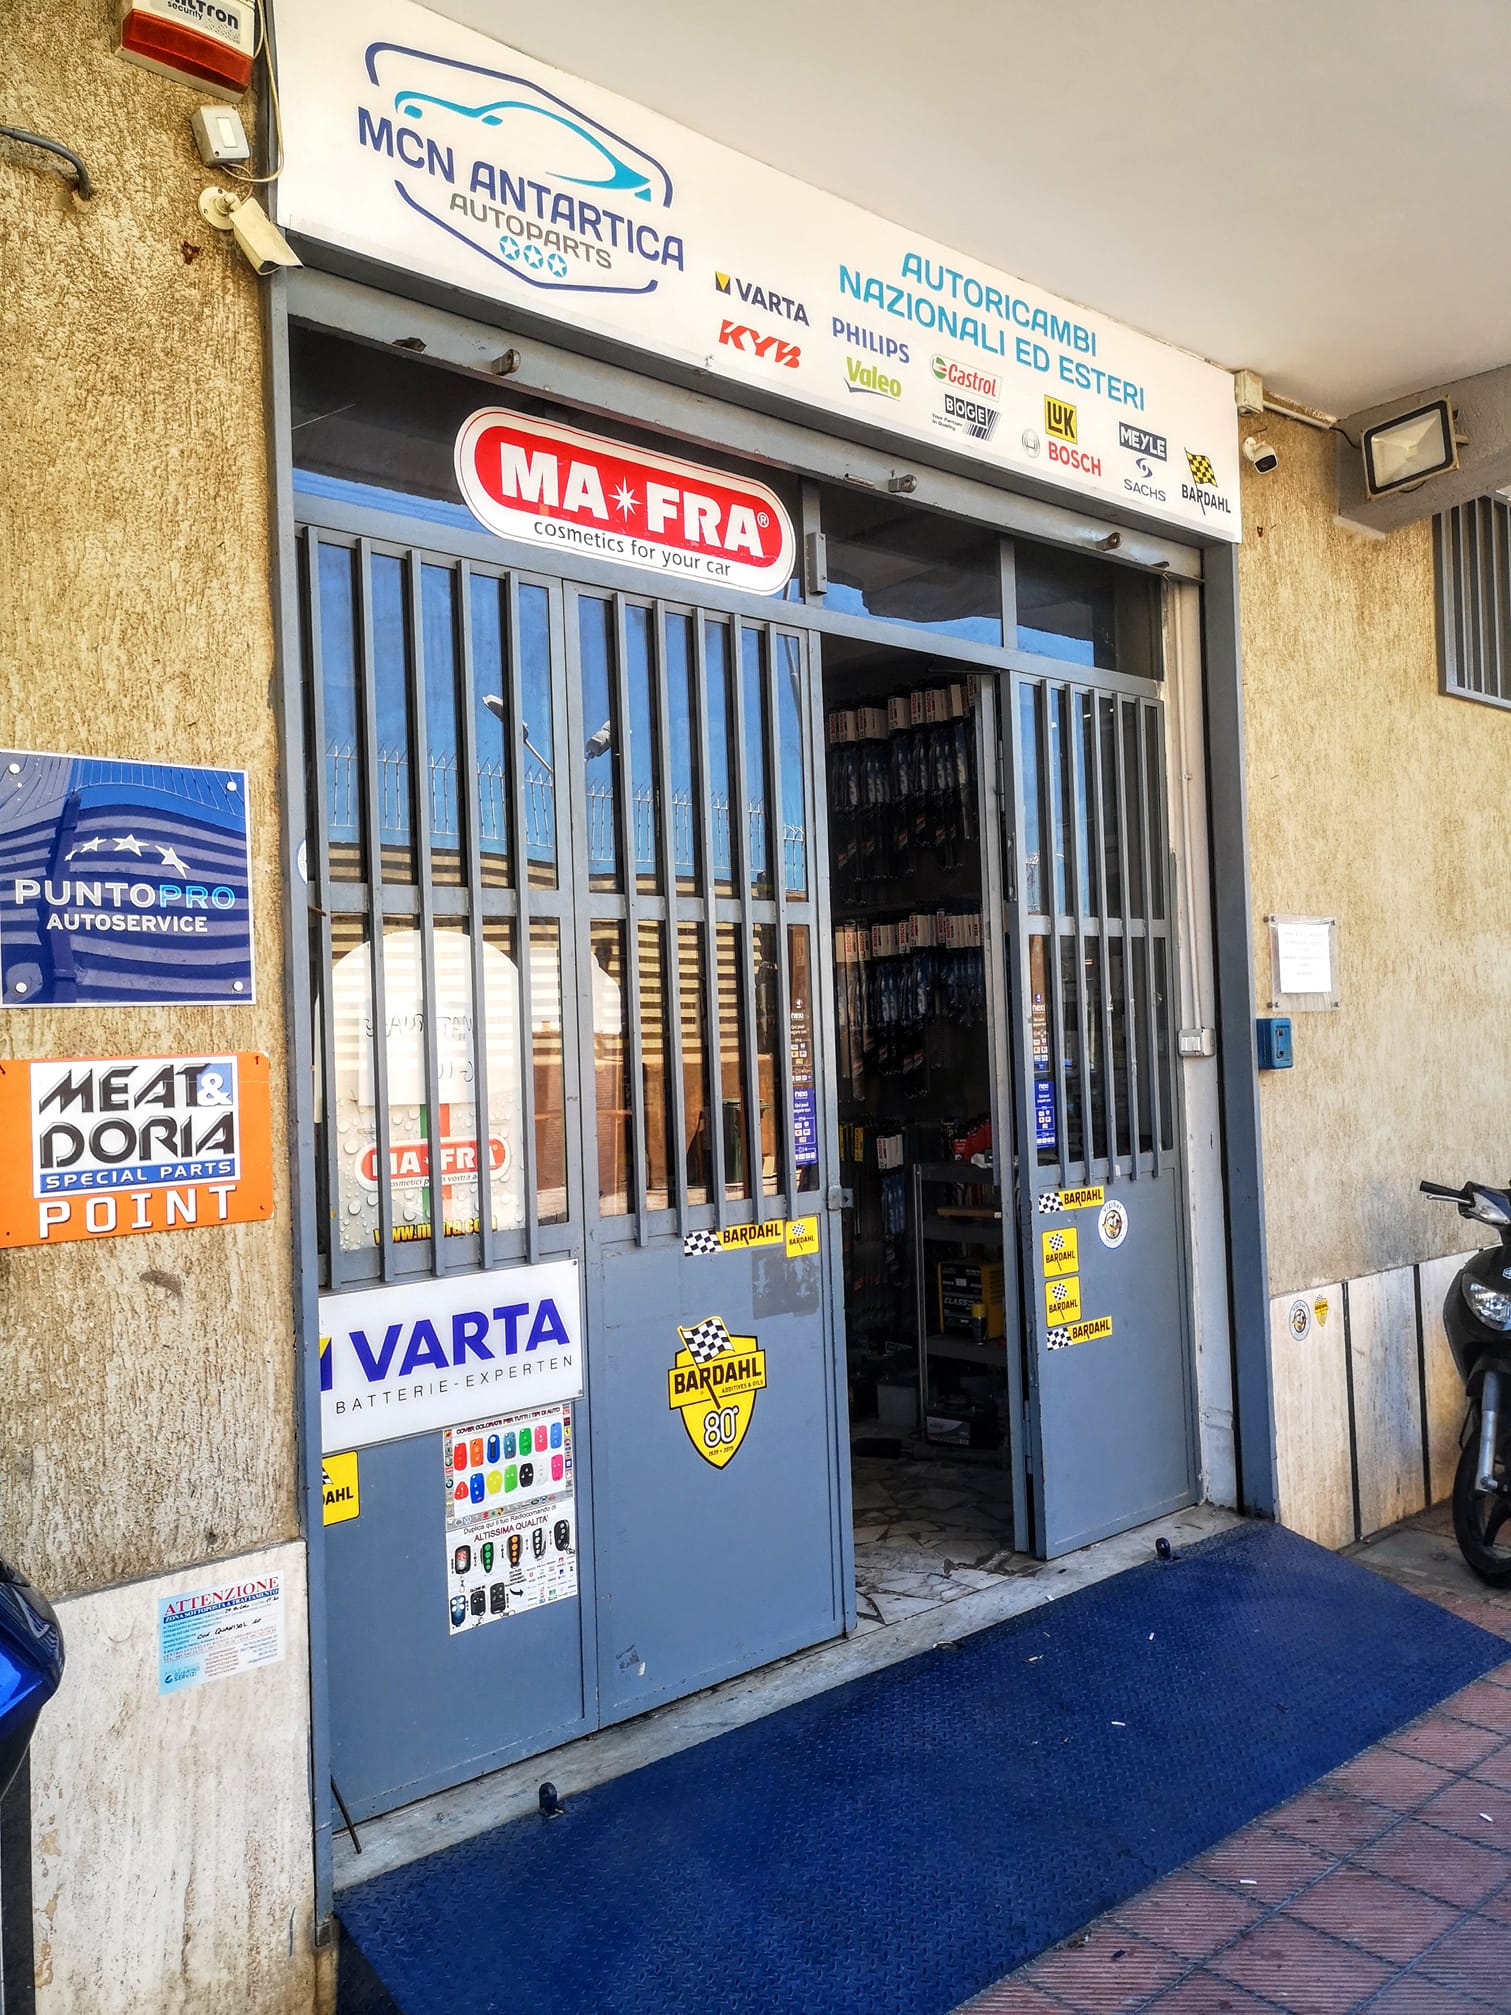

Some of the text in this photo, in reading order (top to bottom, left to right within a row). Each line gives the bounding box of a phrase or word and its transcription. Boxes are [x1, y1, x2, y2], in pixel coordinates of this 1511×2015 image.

[168, 1, 204, 20] security
[357, 106, 686, 273] MCN ANTARTICA
[449, 191, 613, 270] AUTOPARTS
[737, 276, 810, 327] VARTA
[901, 252, 1097, 358] AUTORICAMBI
[719, 319, 801, 369] KYB
[832, 316, 910, 365] PHILIPS
[839, 264, 1145, 412] NAZIONALI ED ESTERI
[846, 356, 902, 398] Valeo
[948, 364, 996, 397] Castrol
[945, 396, 986, 424] BOGE
[1120, 426, 1166, 458] MEYLE
[1048, 441, 1101, 477] BOSCH
[1123, 478, 1167, 502] SACHS
[1181, 484, 1231, 514] BARDAHL
[534, 521, 731, 577] cosmetics for your car
[15, 879, 236, 910] PUNTOPRO
[46, 913, 208, 933] AUTOSERVICE
[40, 1111, 235, 1169] DORIA
[46, 1161, 232, 1189] SPECIAL PARTS
[39, 1184, 237, 1239] POINT
[1064, 1185, 1103, 1206] BARDAHL
[723, 1222, 782, 1245] BARDAHL
[788, 1234, 816, 1246] BARDAHL
[1045, 1249, 1076, 1264] BARDAHL
[1048, 1299, 1079, 1315] BARDAHL
[349, 1298, 571, 1383] VARTA
[1072, 1316, 1111, 1340] BARDAHL
[336, 1355, 573, 1415] BATTERIE-EXPERTEN
[674, 1358, 762, 1395] BARDAHL
[514, 1414, 528, 1422] TUTTI
[547, 1406, 561, 1415] AUTO
[464, 1524, 485, 1535] Duplica
[510, 1506, 550, 1521] Radiocomando
[474, 1525, 515, 1542] ALTISSIMA
[164, 1613, 184, 1623] ZONA
[184, 1603, 226, 1618] SOTTOPOSTA
[232, 1588, 279, 1606] TRATTAMENTO
[165, 1576, 279, 1615] ATTENZIONE
